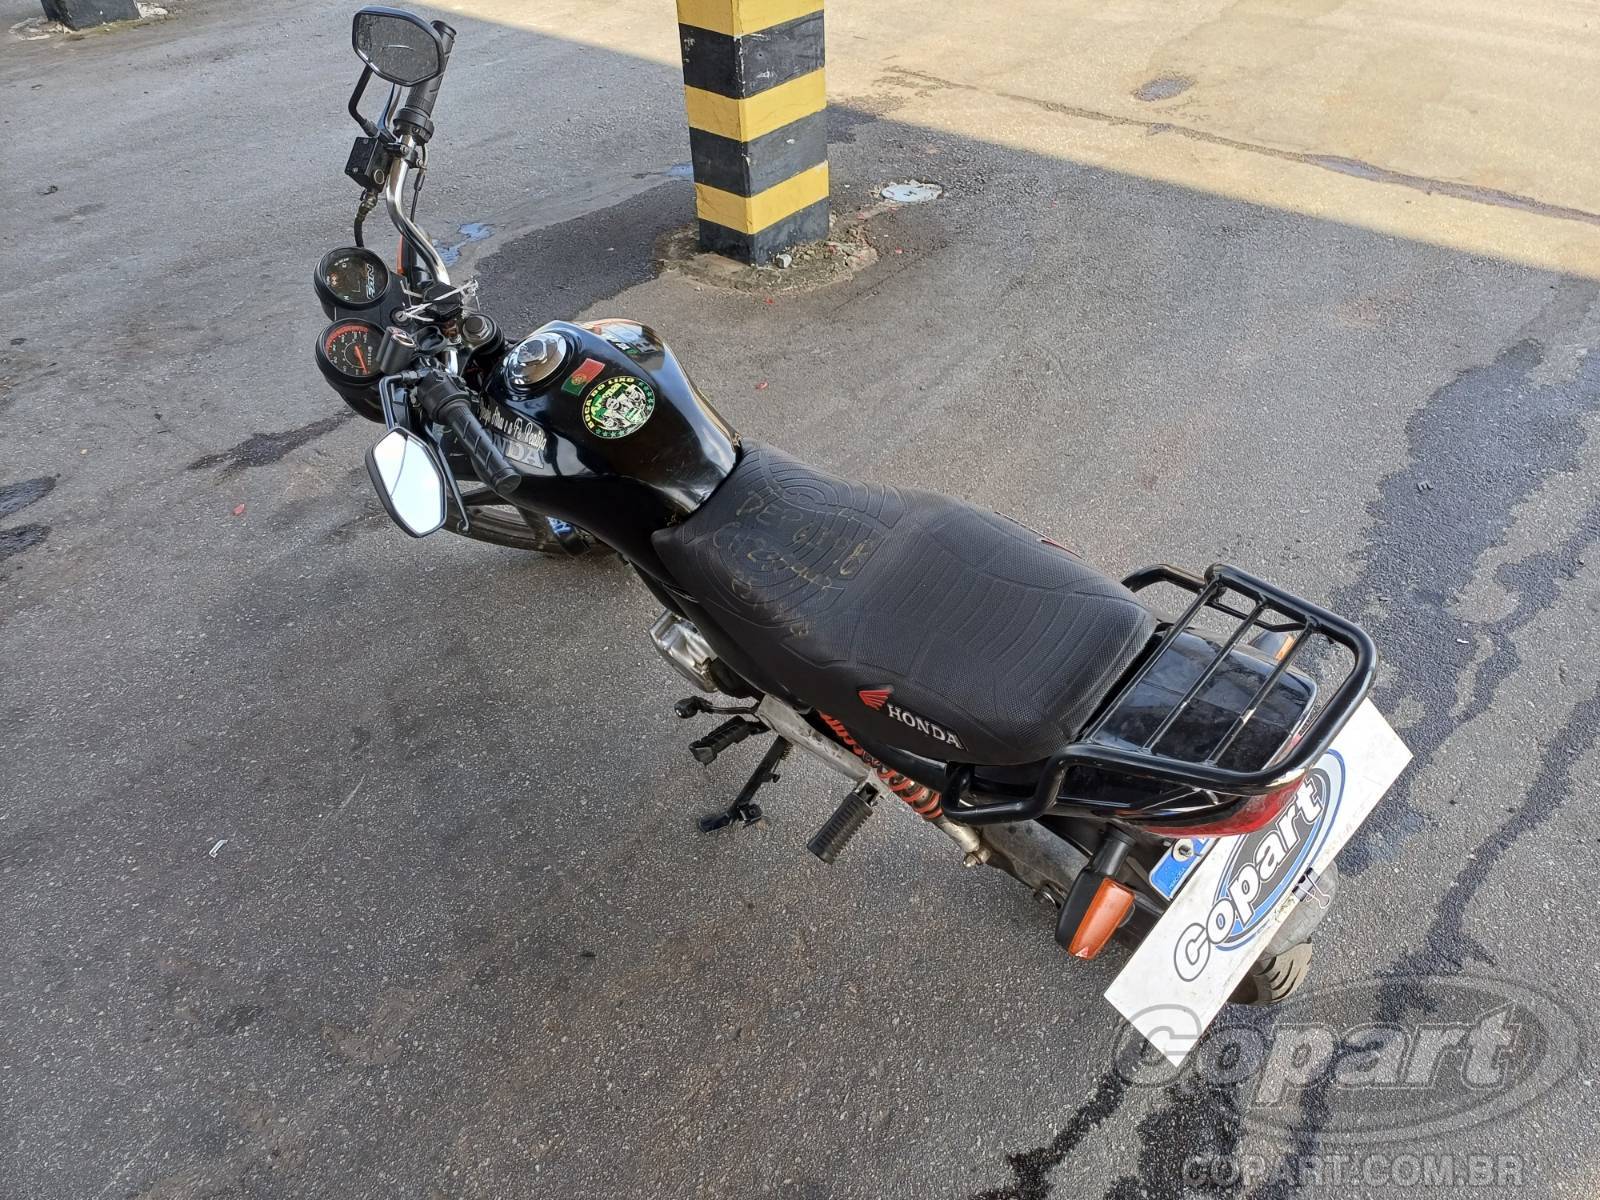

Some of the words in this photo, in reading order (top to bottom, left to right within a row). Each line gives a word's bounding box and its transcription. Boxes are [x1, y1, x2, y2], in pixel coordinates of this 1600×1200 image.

[584, 399, 595, 429] BOCA
[591, 383, 606, 398] DO
[607, 377, 635, 386] LIXO
[493, 435, 544, 469] NDA
[886, 703, 962, 748] HONDA
[1173, 774, 1325, 983] Copart
